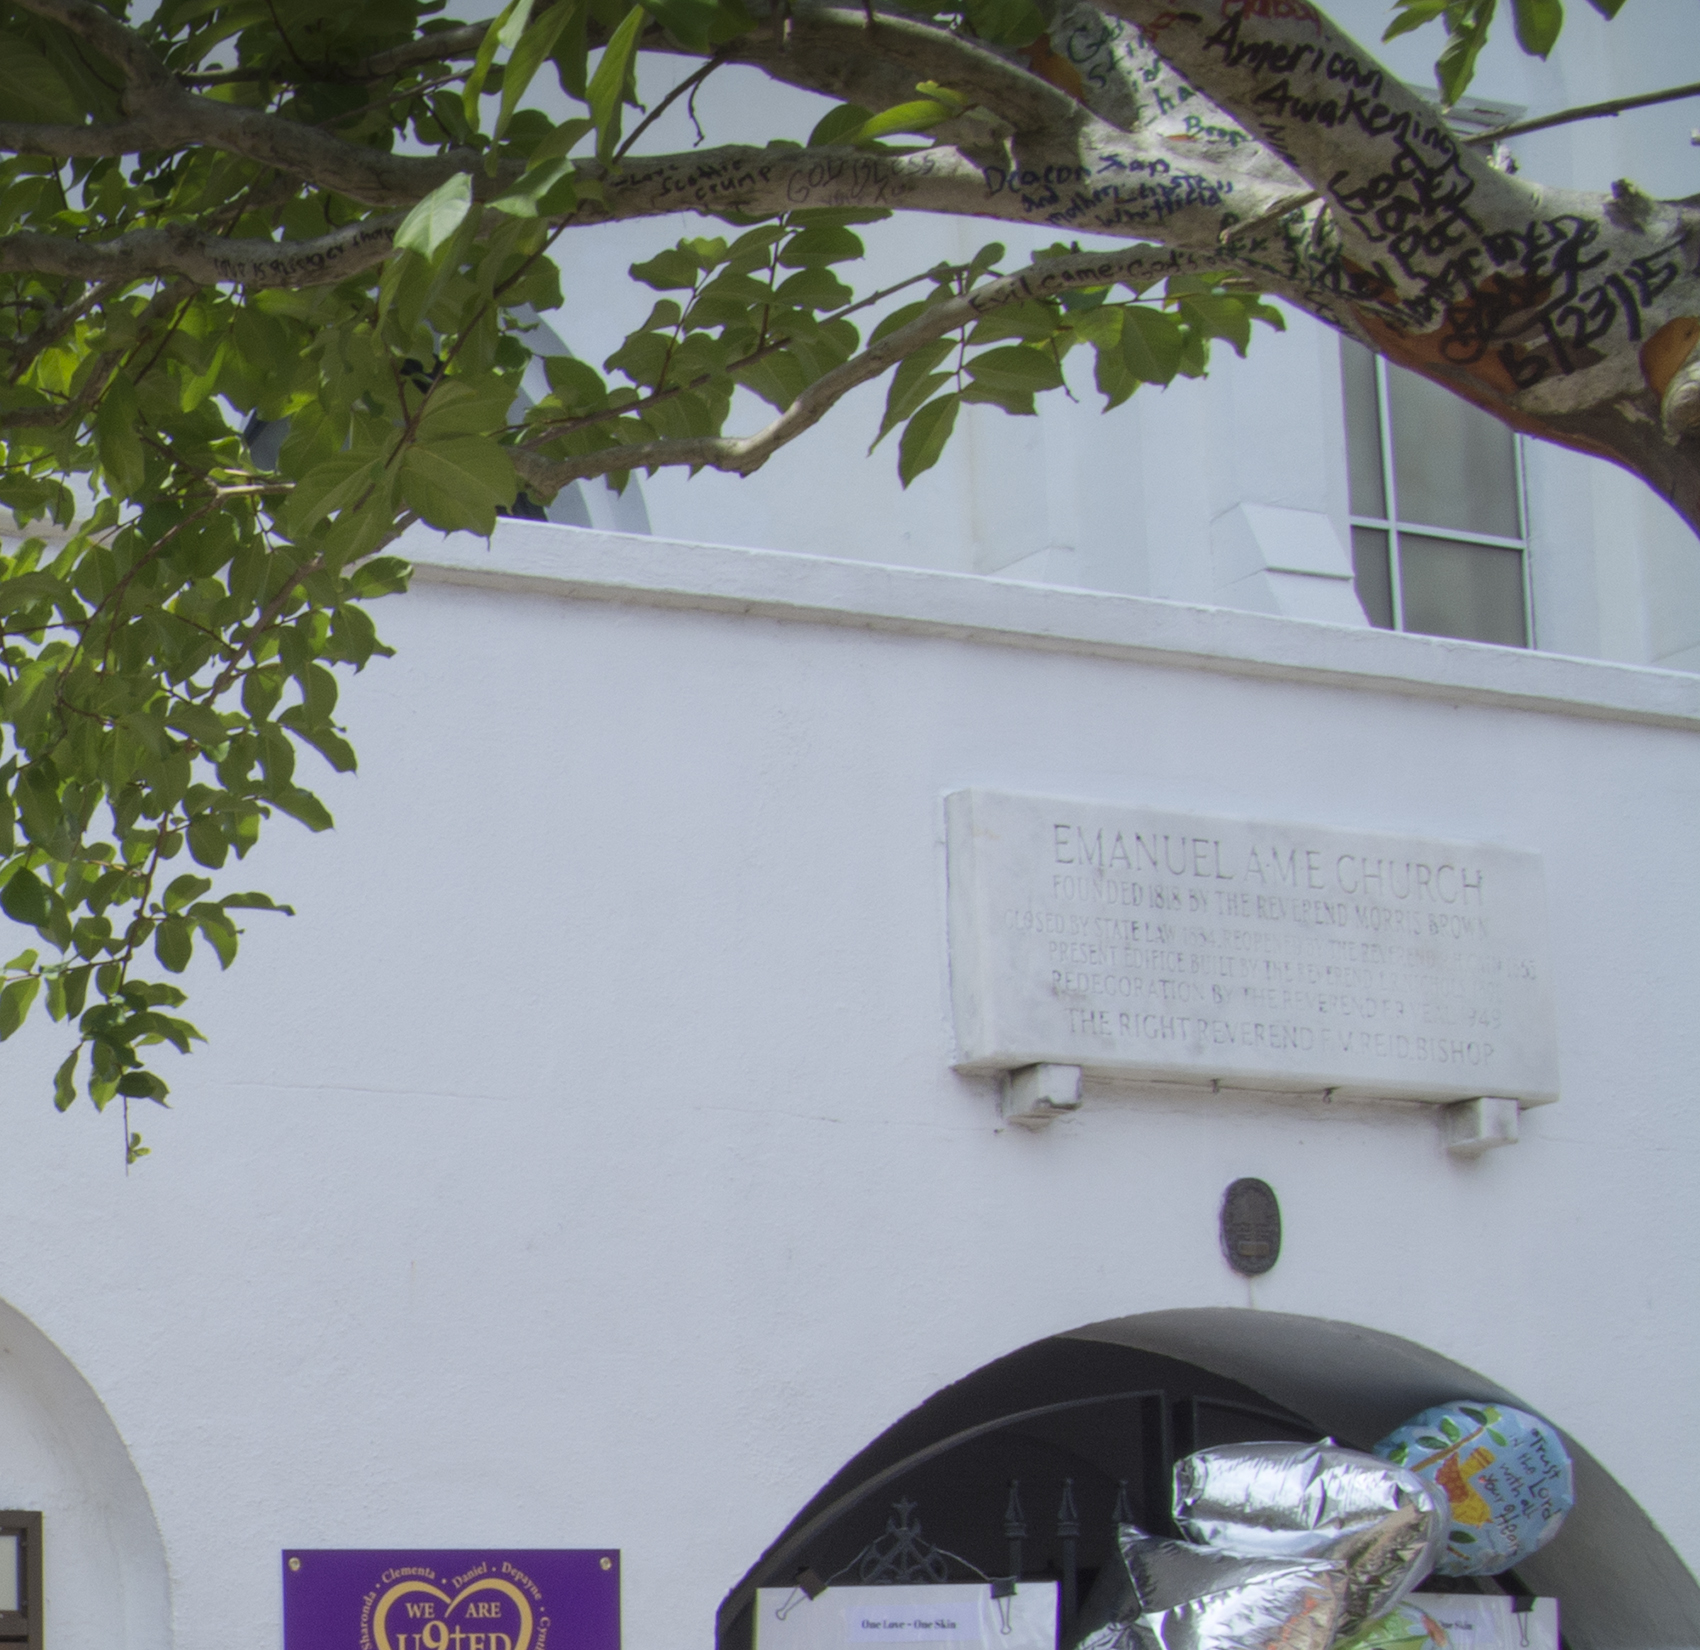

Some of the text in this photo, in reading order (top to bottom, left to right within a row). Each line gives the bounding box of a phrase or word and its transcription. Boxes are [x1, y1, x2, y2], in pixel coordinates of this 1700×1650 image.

[1053, 823, 1234, 881] EMANUEL
[1336, 853, 1484, 907] CHURCH
[1053, 874, 1144, 907] FOUNDED
[1188, 888, 1208, 913] BY
[1215, 890, 1251, 918] THE
[1256, 894, 1348, 928] REVEREND
[1094, 917, 1140, 942] STATE
[1066, 1008, 1113, 1037] THE
[1119, 1012, 1191, 1041] RIGHT
[1196, 1018, 1315, 1051] REVEREND
[381, 1563, 437, 1584] Clementa
[451, 1561, 488, 1590] Daniel
[501, 1561, 543, 1602] Depayne
[405, 1602, 502, 1619] WE ARE
